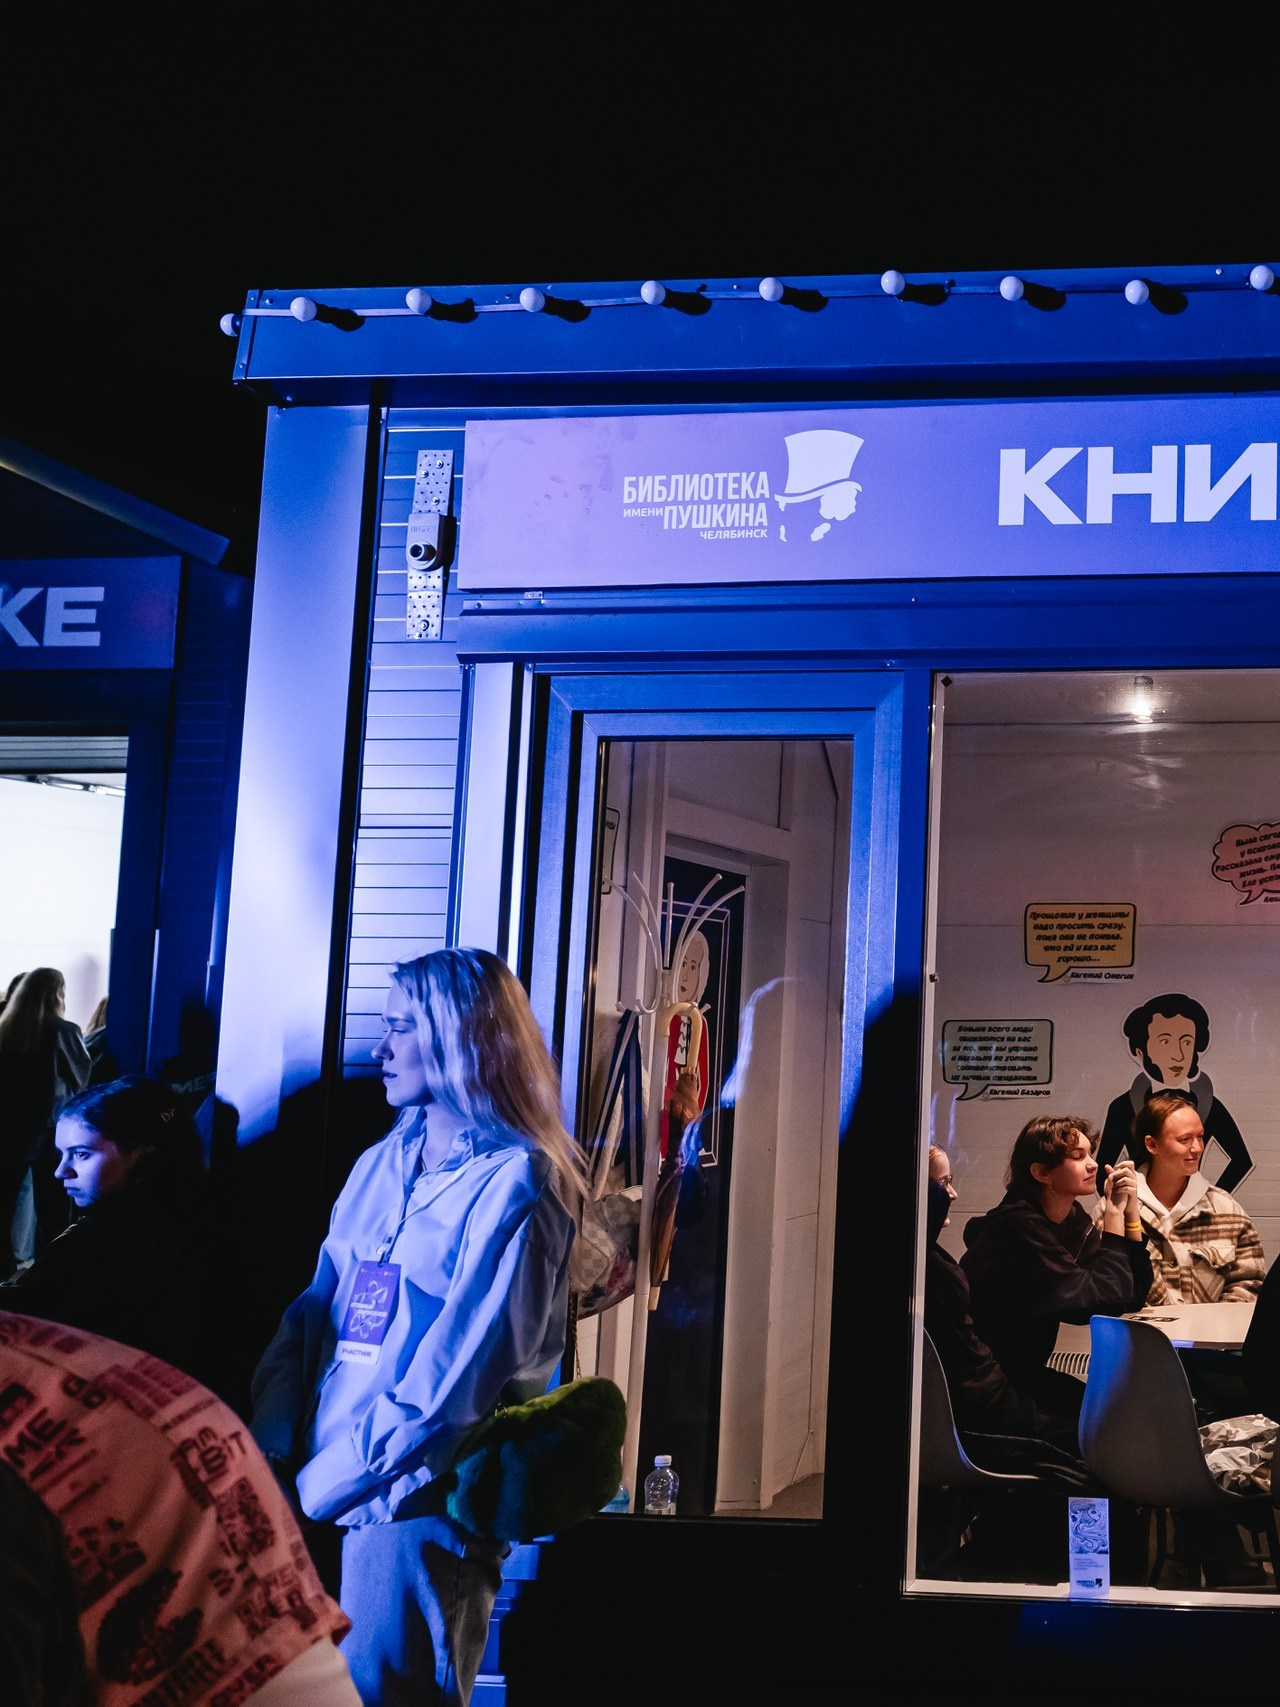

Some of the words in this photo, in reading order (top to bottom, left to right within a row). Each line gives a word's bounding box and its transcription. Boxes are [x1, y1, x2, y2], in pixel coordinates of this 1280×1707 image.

[623, 472, 770, 503] БИБЛИОТЕКА
[623, 508, 663, 517] ИМЕНИ
[663, 502, 768, 529] ПУШКИНА
[700, 529, 768, 539] ЧЕЛЯБИНСК
